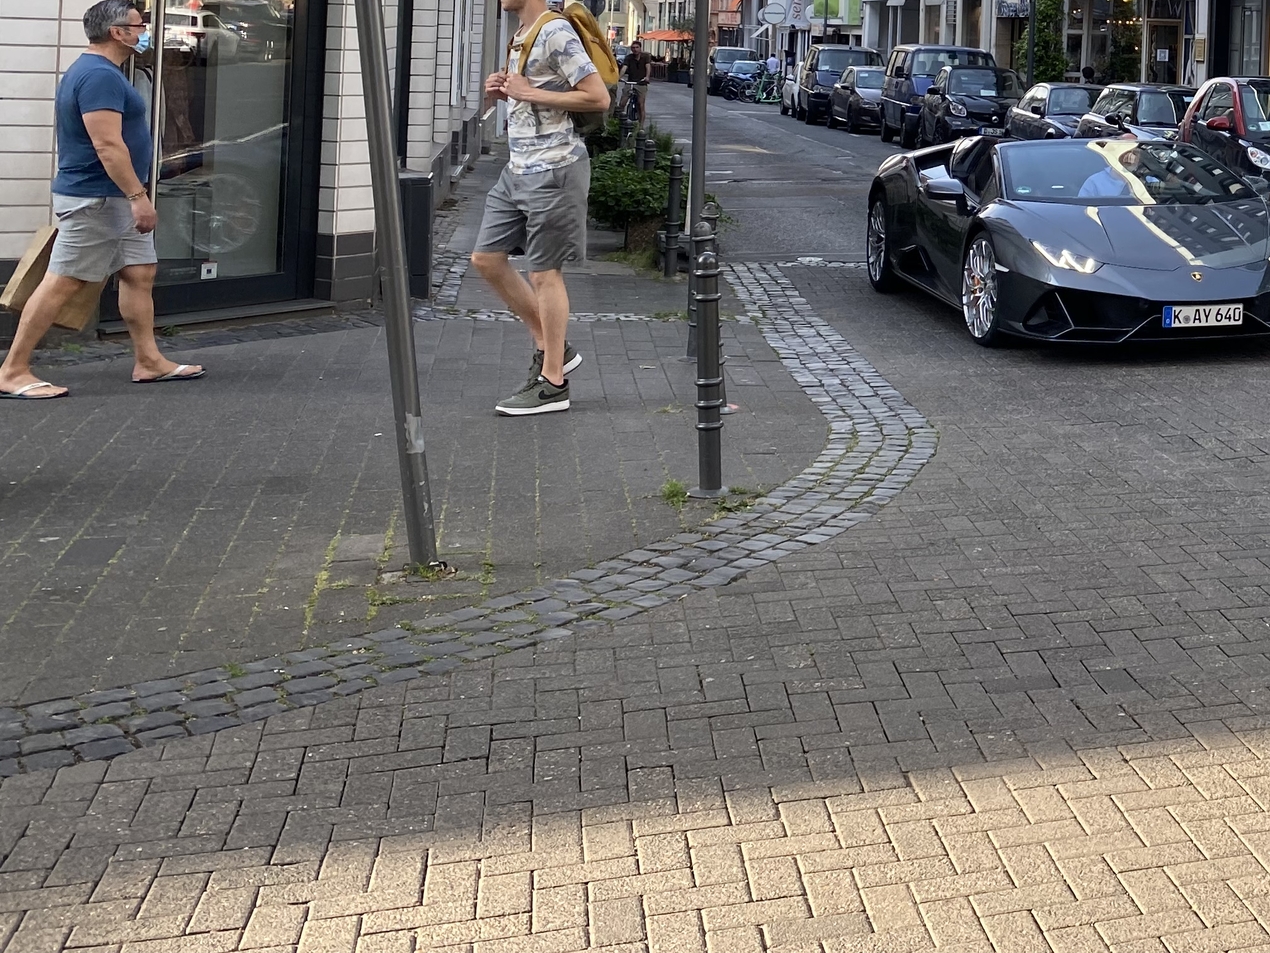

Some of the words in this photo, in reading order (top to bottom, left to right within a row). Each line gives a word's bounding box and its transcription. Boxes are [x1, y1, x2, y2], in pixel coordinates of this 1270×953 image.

[1173, 309, 1182, 324] K
[1193, 308, 1211, 323] AY
[1215, 307, 1241, 322] 640
